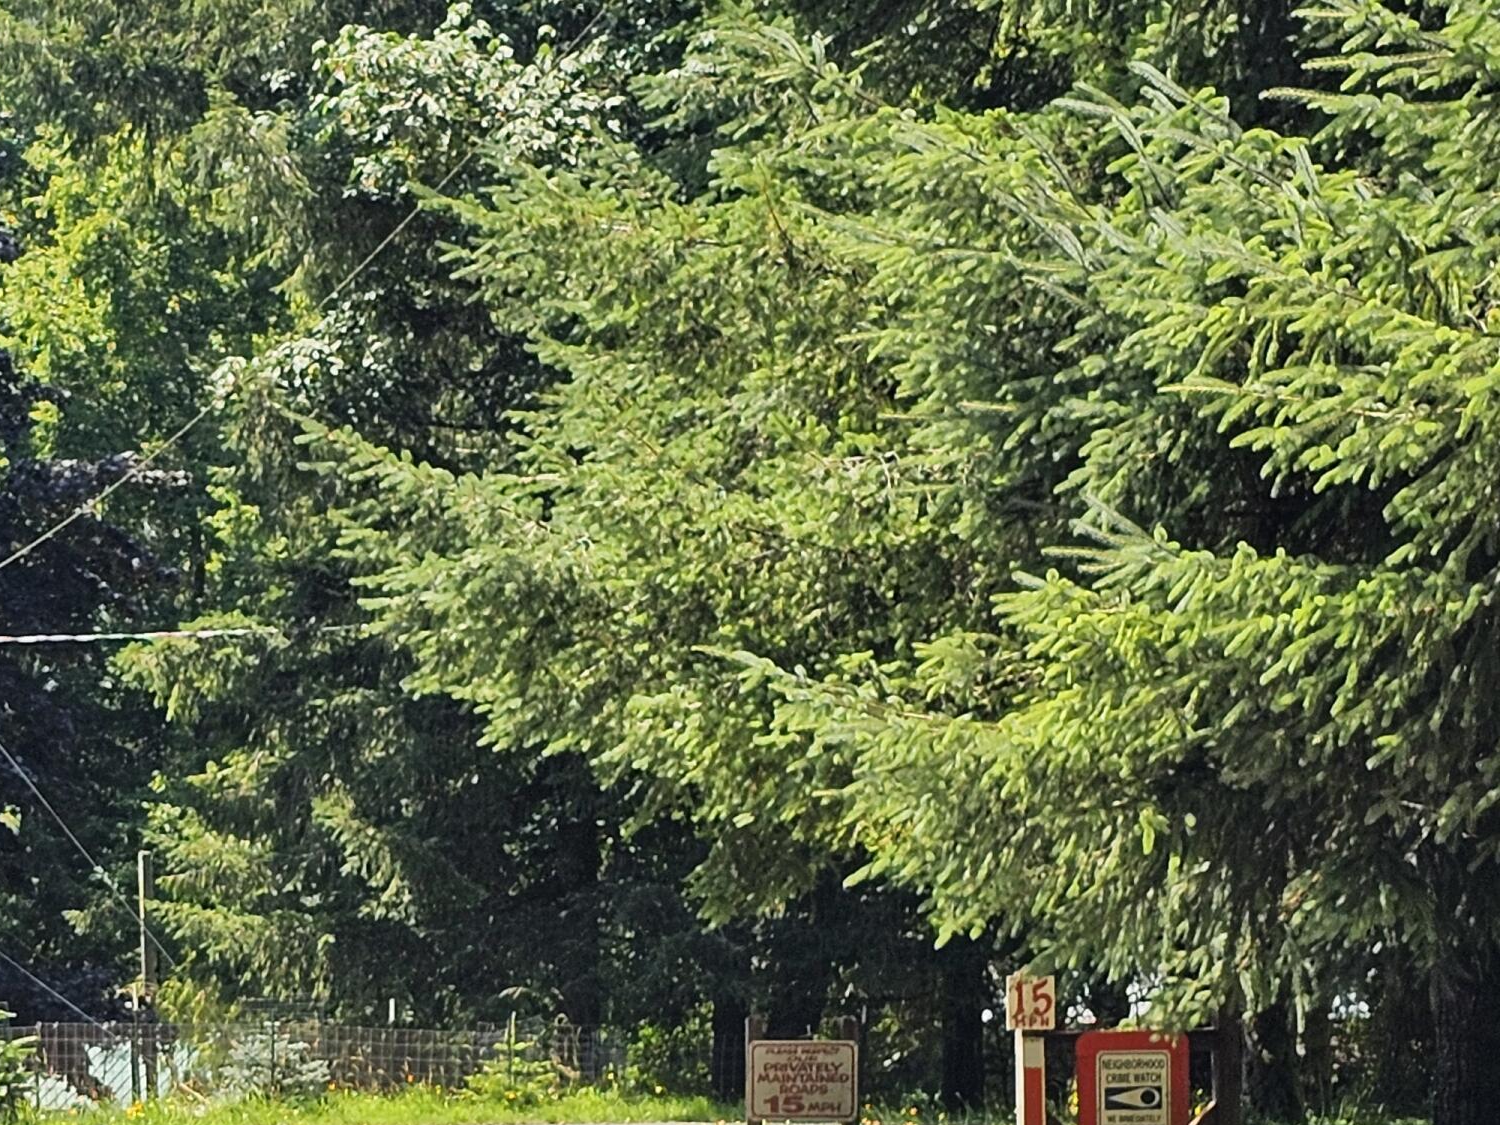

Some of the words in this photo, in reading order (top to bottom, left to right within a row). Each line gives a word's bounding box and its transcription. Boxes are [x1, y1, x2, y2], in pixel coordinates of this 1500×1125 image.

[1014, 978, 1053, 1016] 15
[1011, 1014, 1049, 1028] MPH
[763, 1062, 844, 1073] PRIVATELY
[757, 1072, 850, 1084] MAINTAINED
[1133, 1071, 1162, 1082] WATCH
[780, 1084, 828, 1095] ROADS
[763, 1095, 805, 1114] 15
[807, 1101, 842, 1113] MPH
